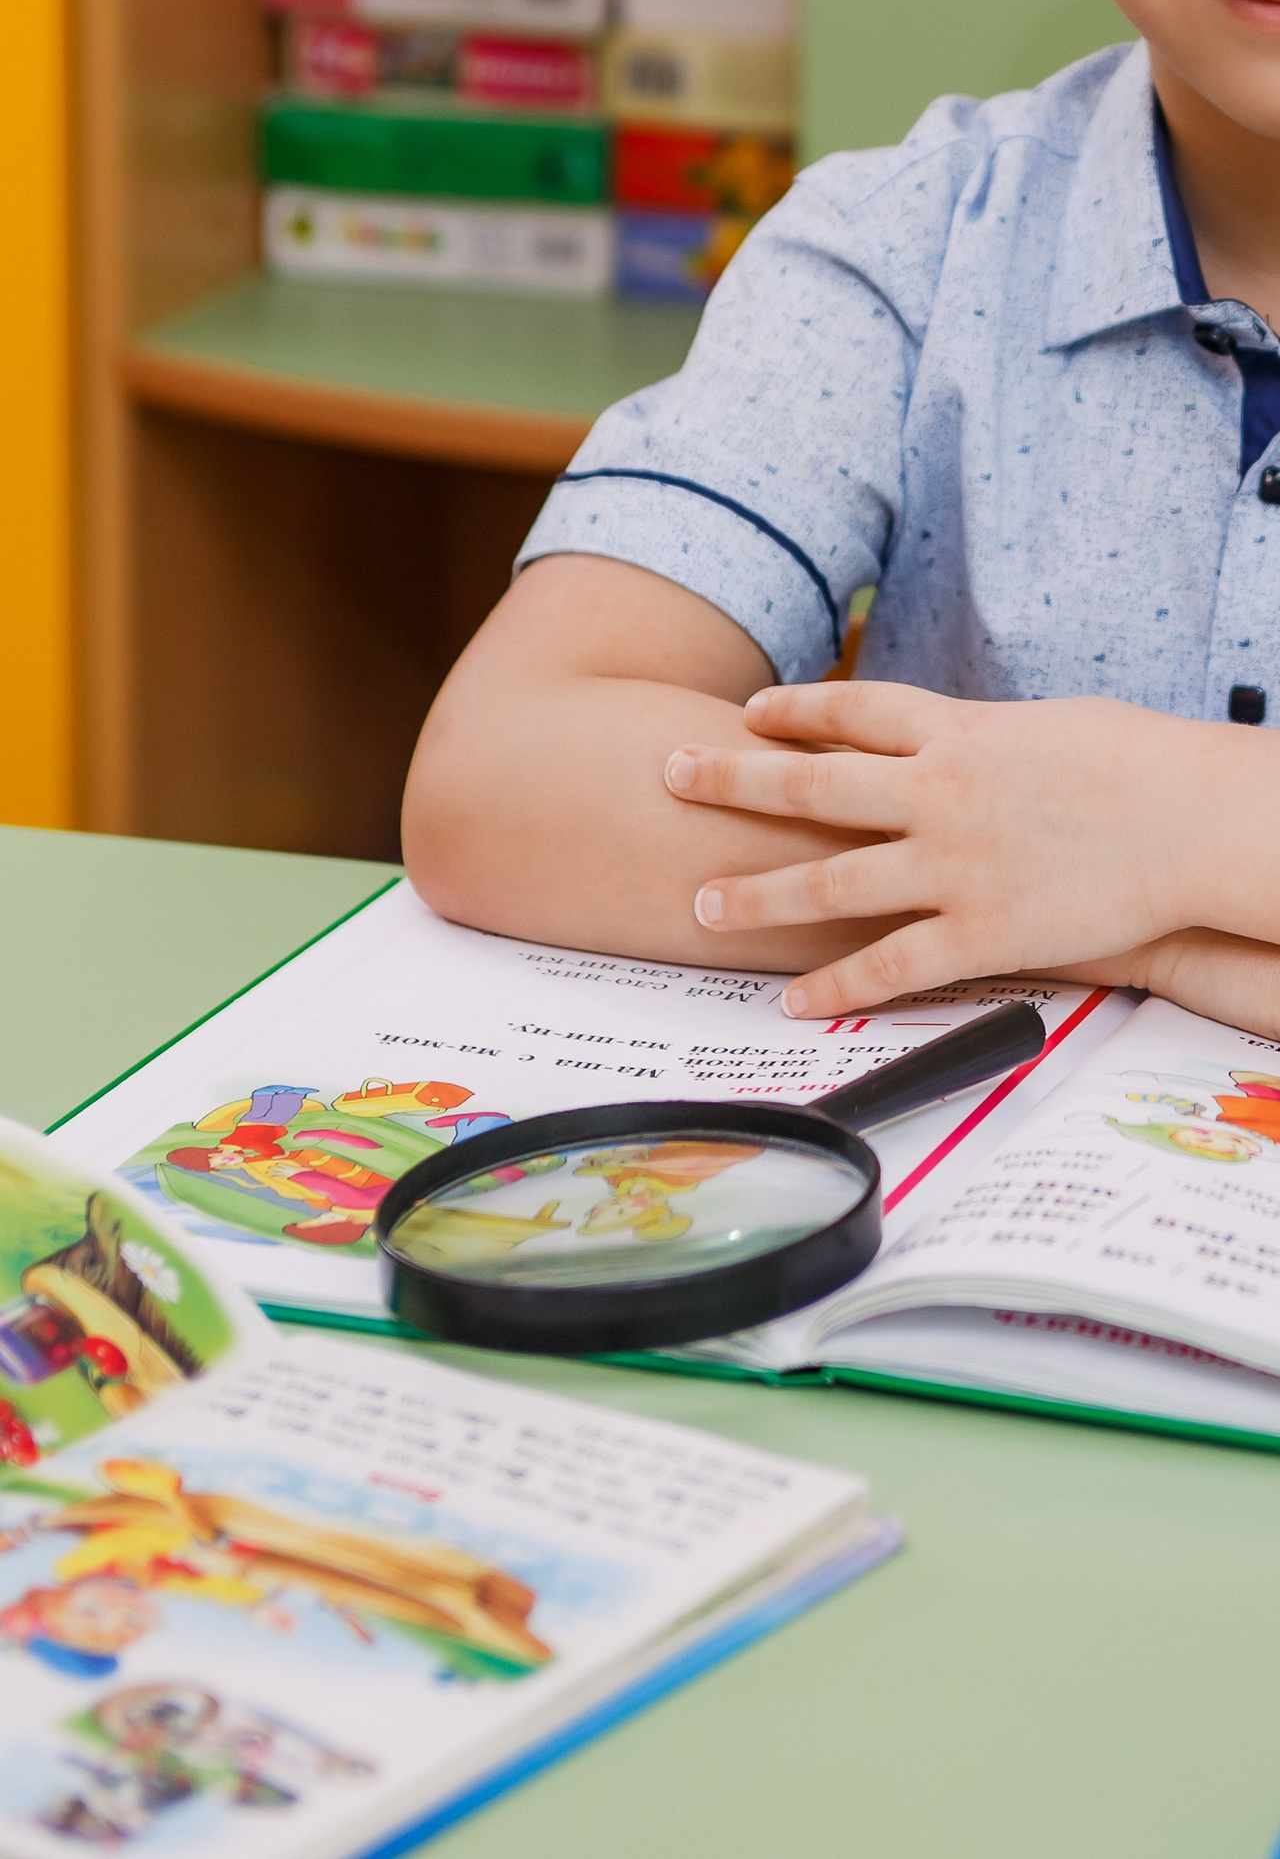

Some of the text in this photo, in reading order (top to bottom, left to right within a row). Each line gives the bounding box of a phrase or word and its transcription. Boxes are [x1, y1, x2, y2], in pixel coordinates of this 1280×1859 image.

[517, 952, 770, 992] Мои сло-ни-ки.
[534, 966, 756, 1004] Мой сло-ник.
[985, 986, 1060, 1001] Мои
[506, 1021, 672, 1053] ма-ши-ну.
[373, 1032, 504, 1059] ма-мой.
[686, 1044, 818, 1057] от-крой
[516, 1053, 536, 1063] с
[677, 1057, 820, 1070] лай-кой.
[554, 1058, 667, 1080] Ма-ша
[687, 1070, 810, 1082] па-пой.
[728, 1083, 846, 1095] ши-ны.
